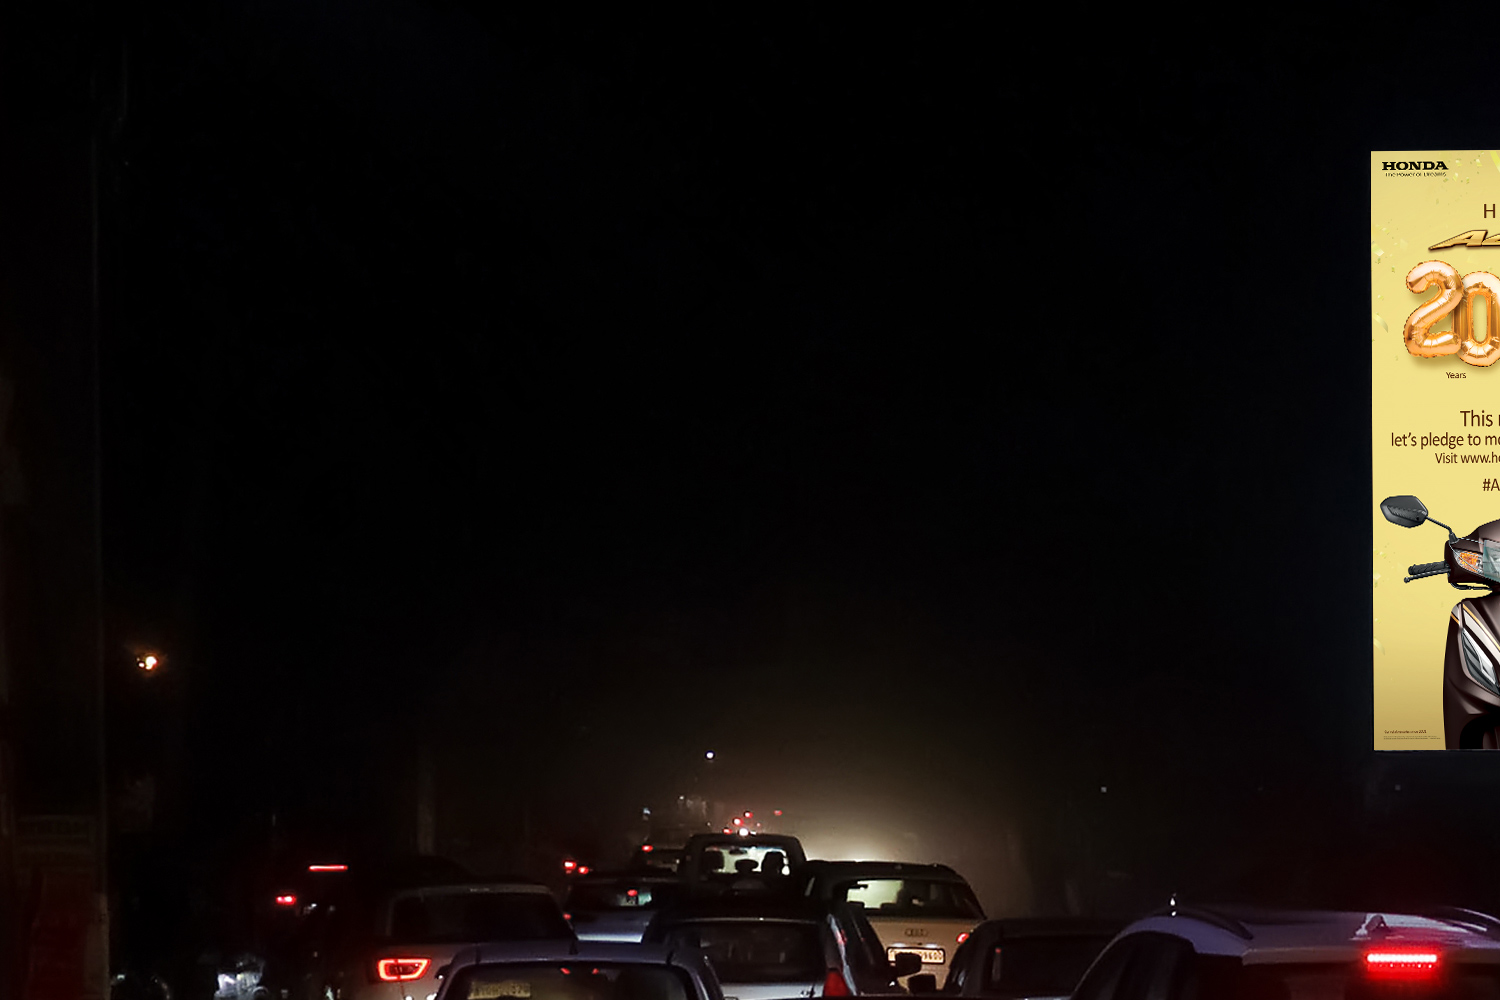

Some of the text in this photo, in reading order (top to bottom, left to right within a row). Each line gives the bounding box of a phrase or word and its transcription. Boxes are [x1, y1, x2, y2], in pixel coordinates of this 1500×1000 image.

[1381, 161, 1449, 170] HONDA
[1445, 371, 1467, 379] Years
[1460, 410, 1493, 427] This
[1420, 432, 1464, 450] pledge
[1467, 434, 1481, 446] to
[1435, 452, 1458, 464] Visit
